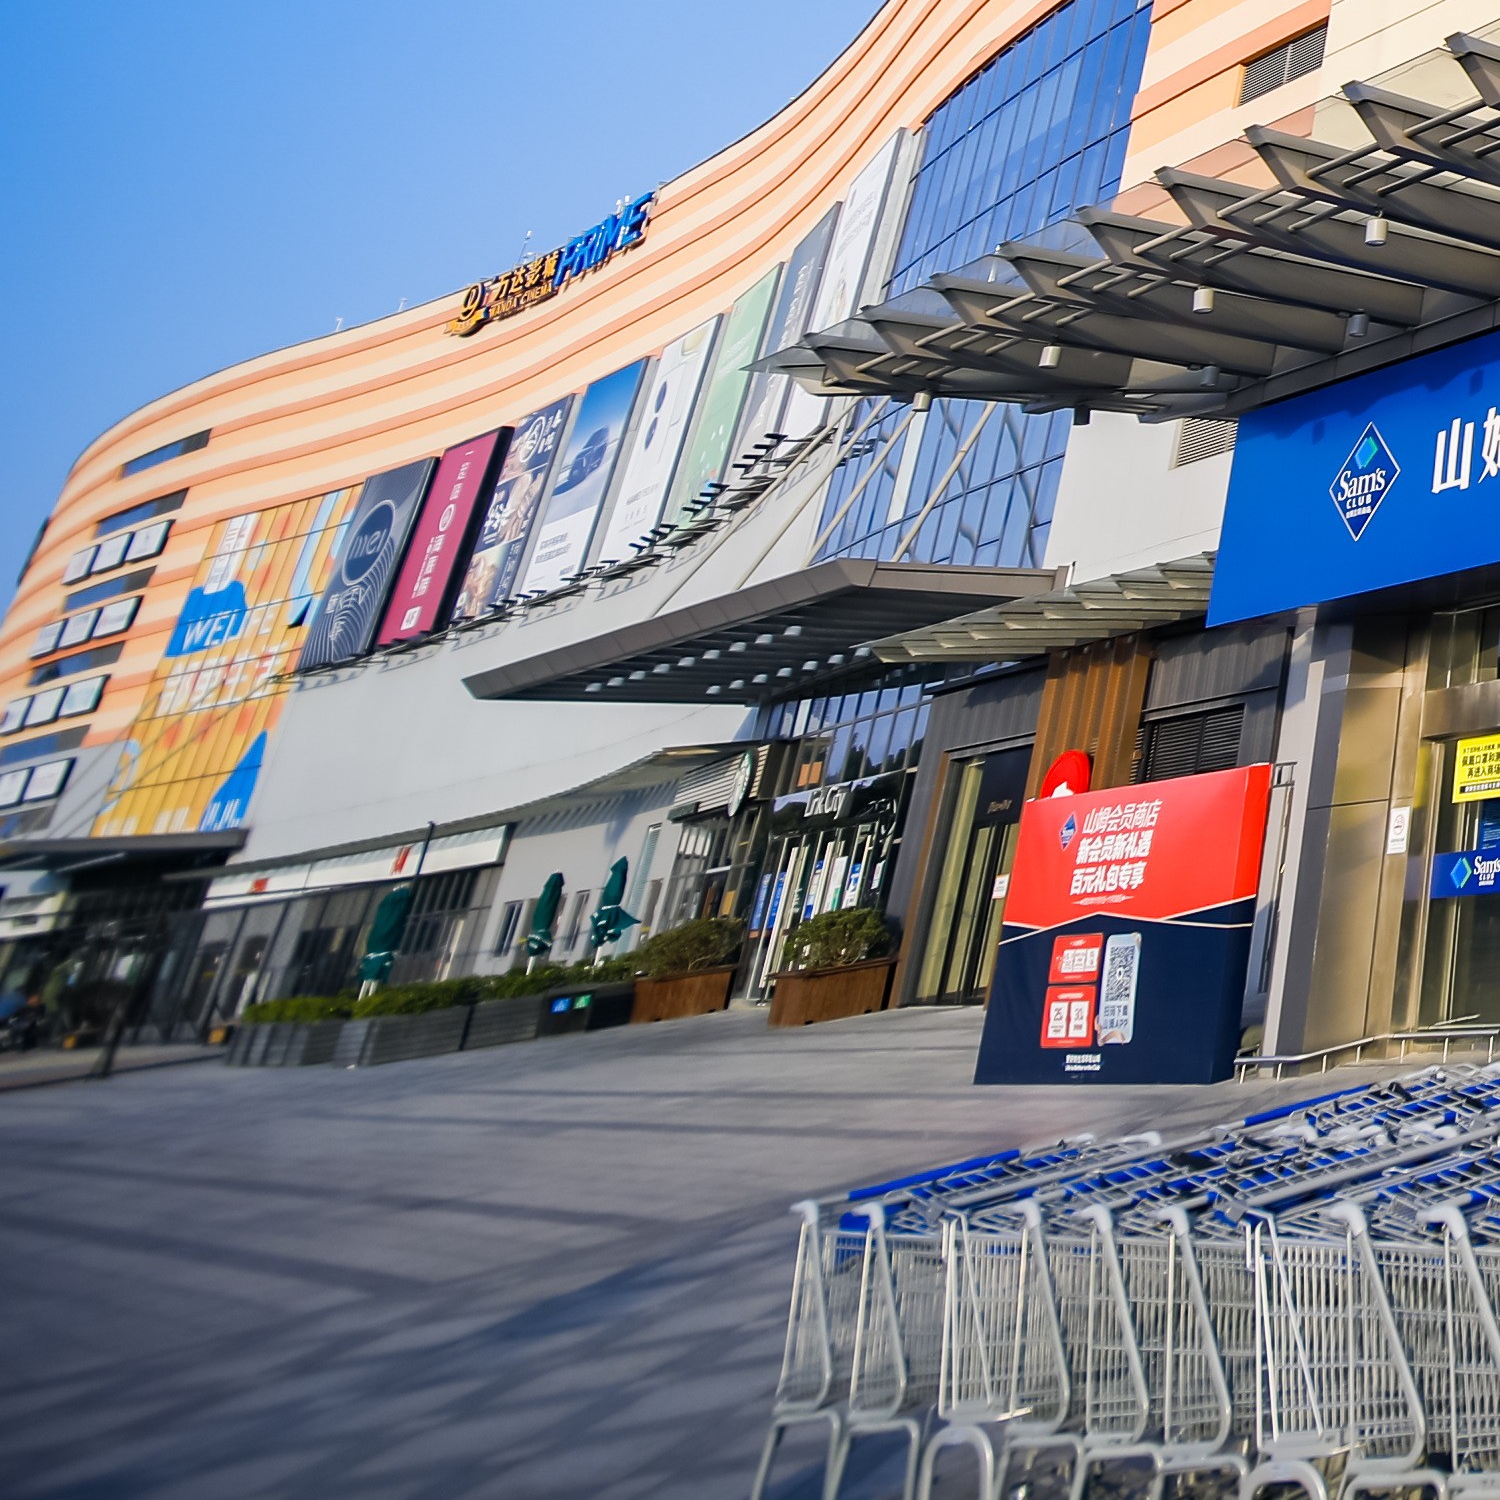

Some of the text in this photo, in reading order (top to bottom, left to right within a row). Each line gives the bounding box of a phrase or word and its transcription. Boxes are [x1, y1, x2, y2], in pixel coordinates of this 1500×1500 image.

[553, 191, 655, 287] PRIME
[1338, 468, 1386, 501] Sam's
[1346, 494, 1372, 509] CLUB
[1082, 799, 1163, 834] 山姆会员商店
[1076, 830, 1154, 865] 新会员新礼遇
[1070, 860, 1147, 896] 百元礼包专享
